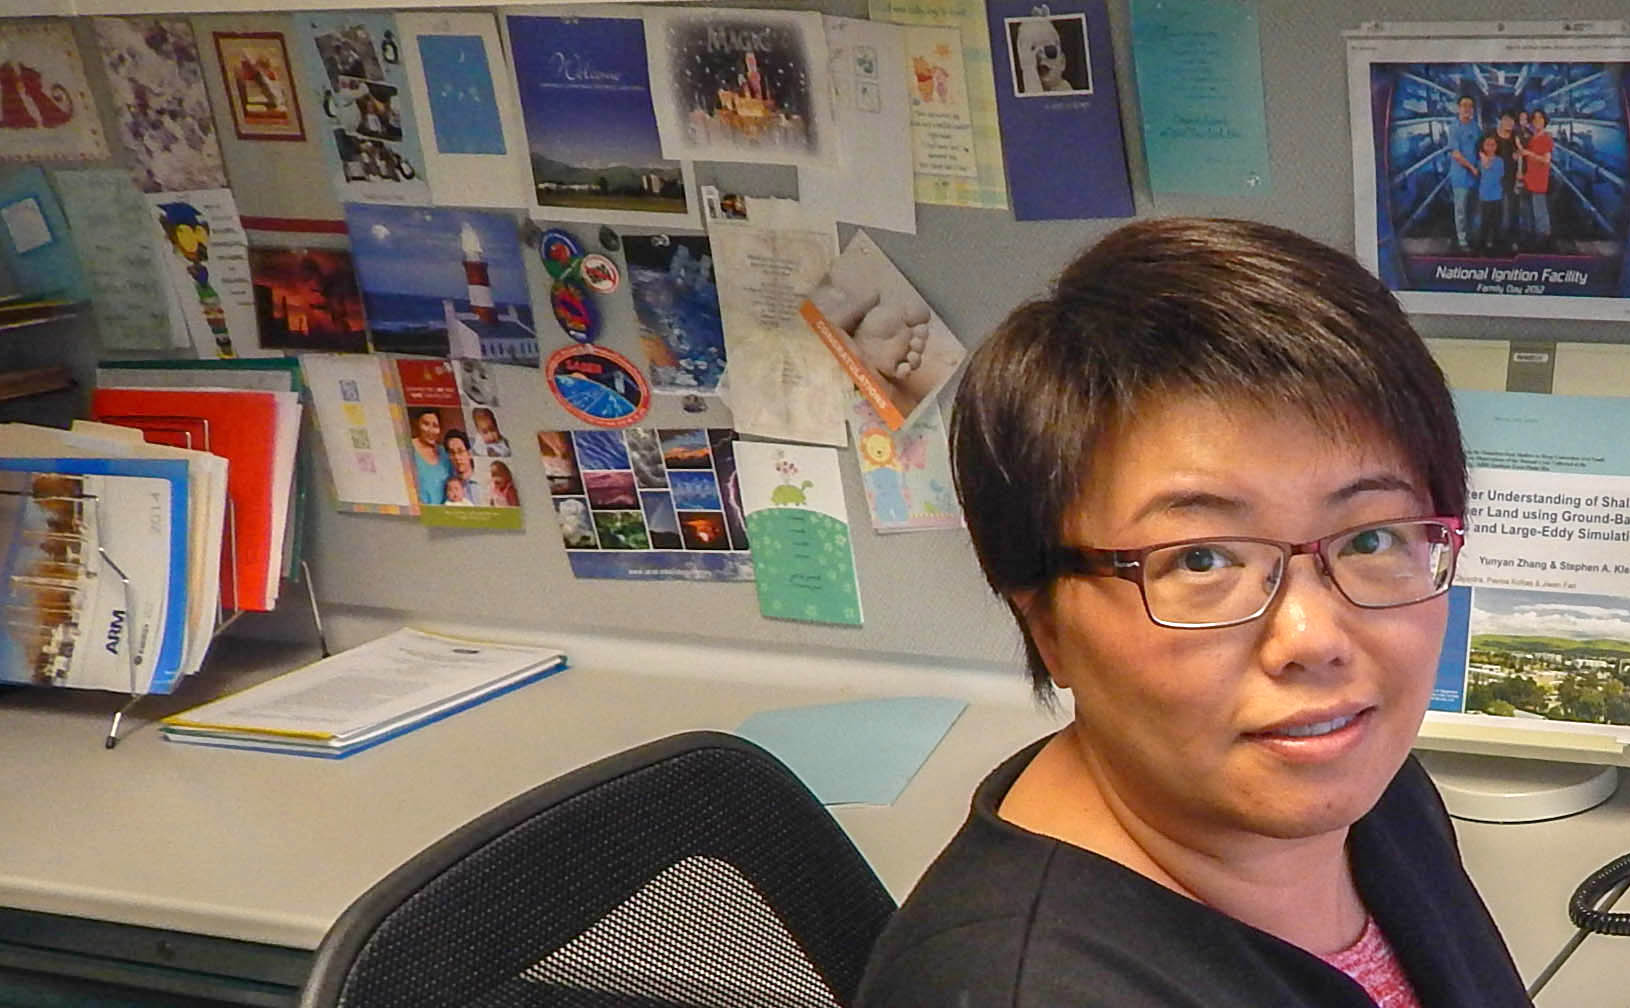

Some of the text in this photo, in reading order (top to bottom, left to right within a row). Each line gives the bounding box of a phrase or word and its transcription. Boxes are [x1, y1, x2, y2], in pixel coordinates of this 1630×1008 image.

[1436, 265, 1589, 285] National Ignition Facility
[1487, 489, 1581, 509] Understanding
[1584, 495, 1599, 507] of
[1487, 506, 1519, 520] Land
[1523, 509, 1558, 524] using
[1473, 522, 1497, 534] and
[1501, 523, 1574, 541] Large-Eddy
[1479, 556, 1515, 569] Yunyan
[1517, 558, 1547, 571] Zhang
[1550, 560, 1557, 569] &
[1559, 561, 1599, 574] Stephen
[1602, 564, 1611, 573] A.
[105, 609, 126, 655] ARM
